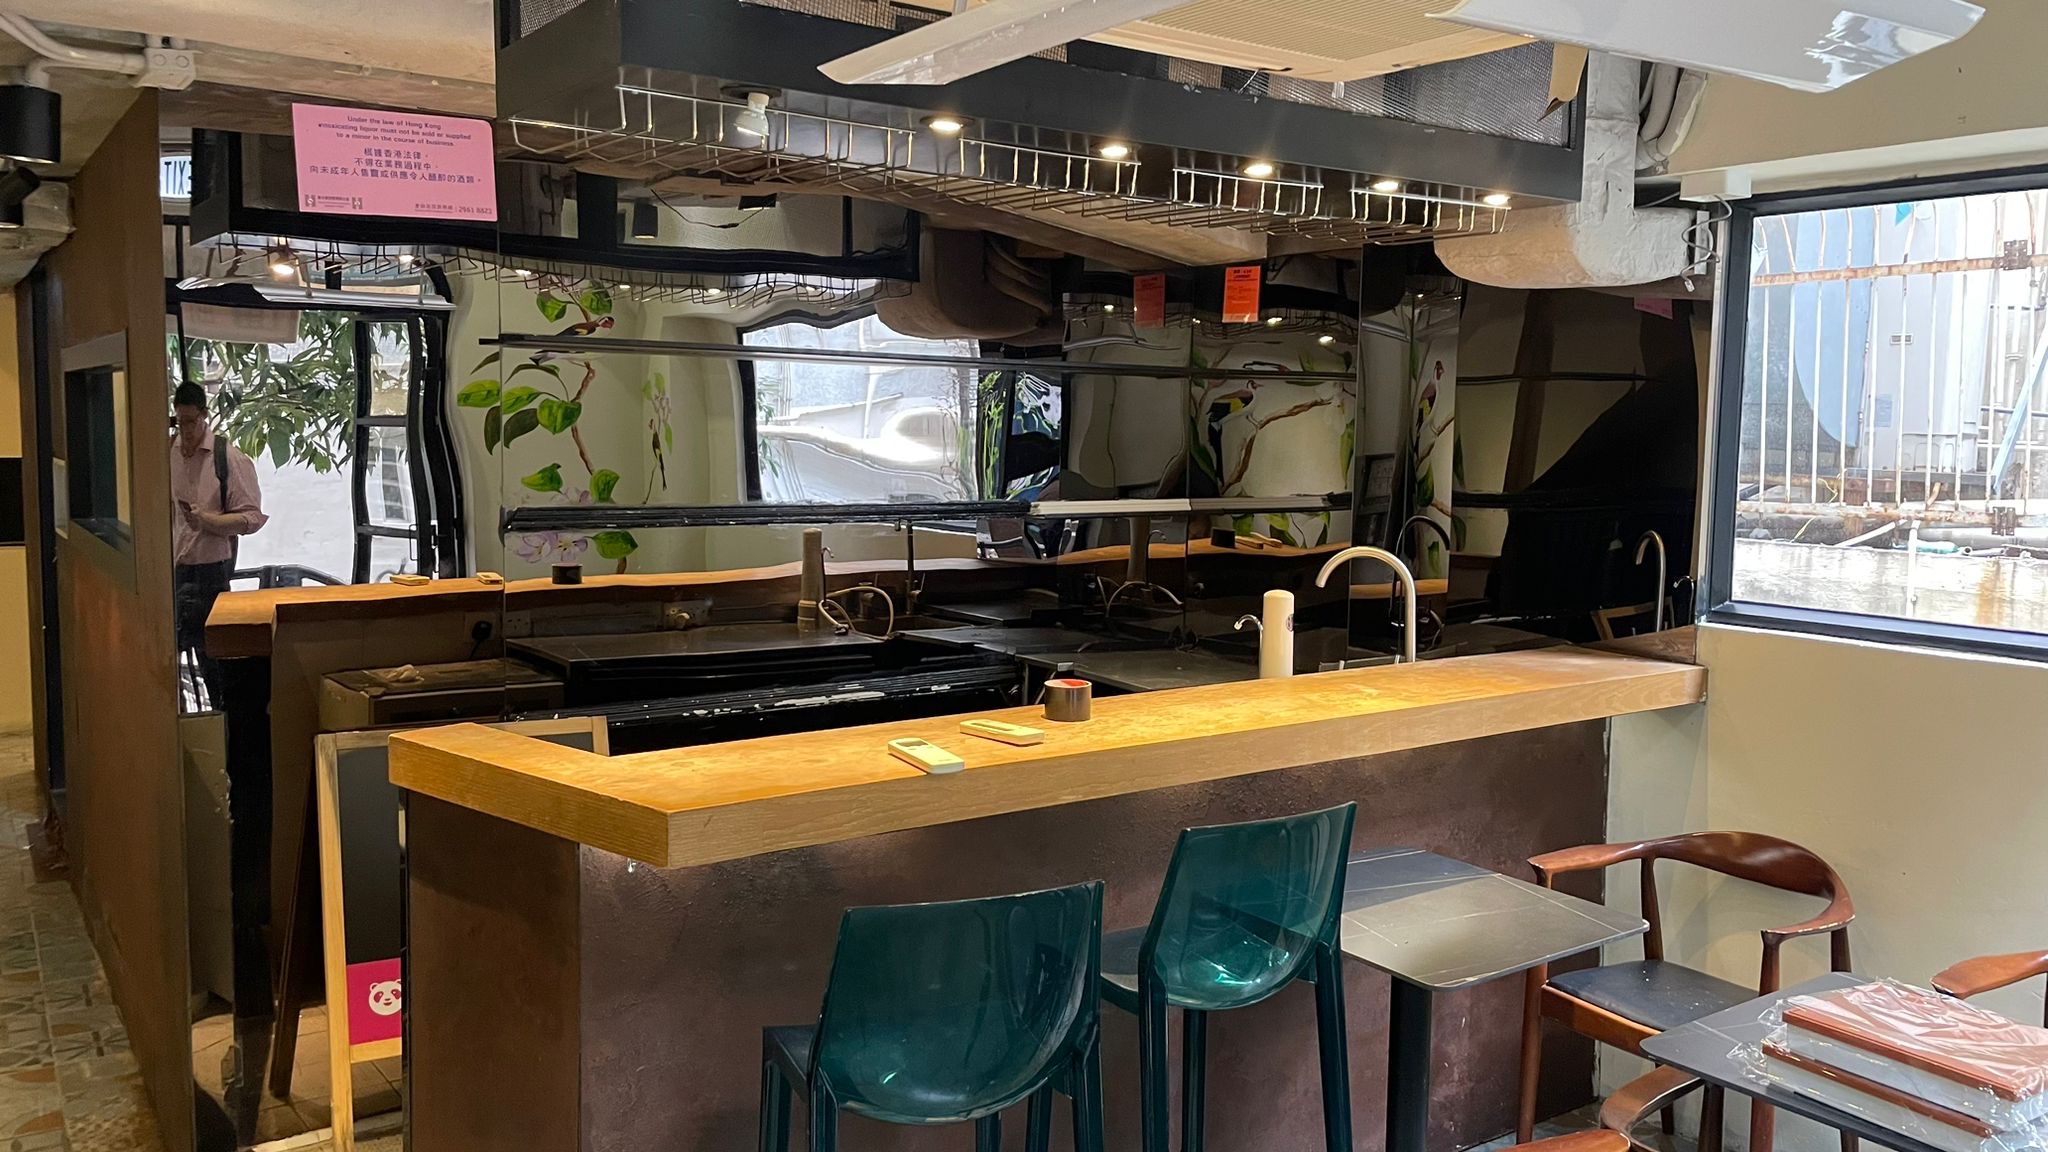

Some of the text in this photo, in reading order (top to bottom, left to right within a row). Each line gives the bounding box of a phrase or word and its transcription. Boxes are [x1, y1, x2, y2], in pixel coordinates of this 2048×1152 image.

[347, 115, 368, 123] Under
[405, 120, 423, 129] Hong
[359, 125, 379, 133] liquor
[445, 132, 472, 140] supplied
[393, 136, 415, 144] course
